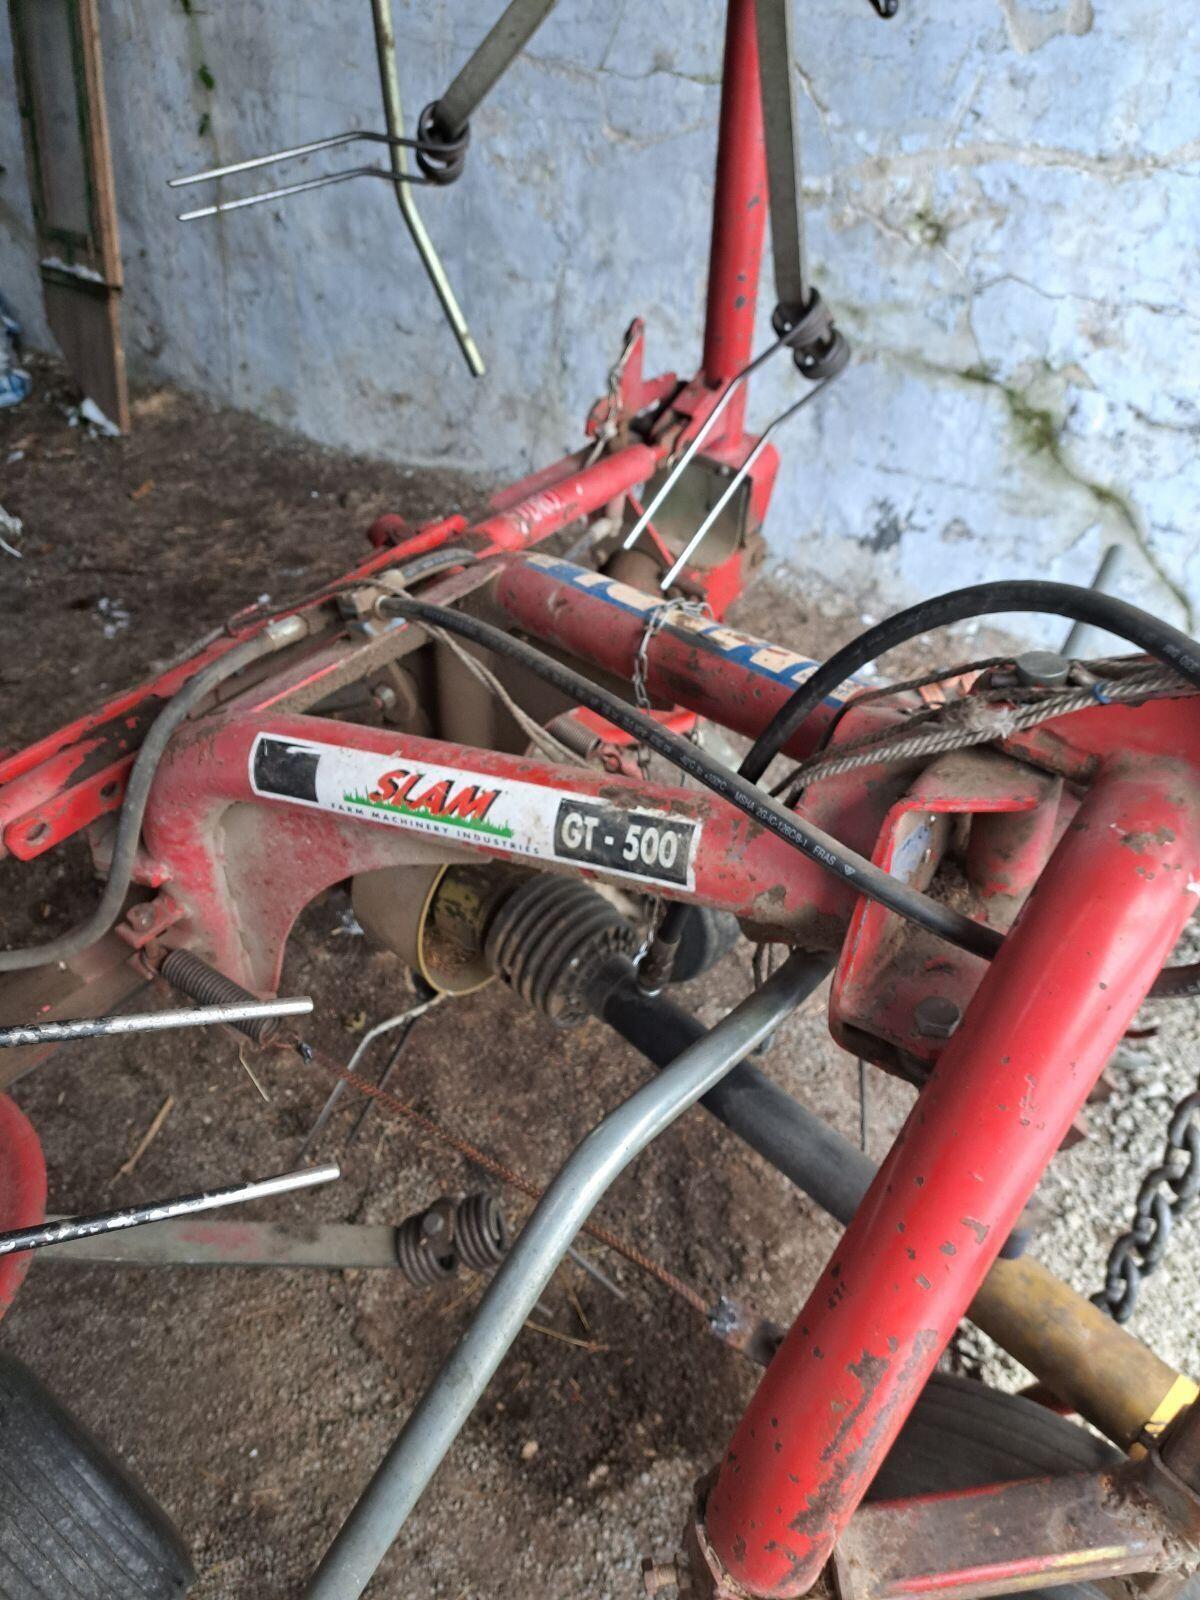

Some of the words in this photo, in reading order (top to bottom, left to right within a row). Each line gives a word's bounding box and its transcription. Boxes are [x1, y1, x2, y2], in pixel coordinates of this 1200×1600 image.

[368, 769, 502, 822] SLAM
[331, 802, 364, 816] FARM
[371, 811, 449, 835] MACHINERY
[456, 830, 540, 855] INDUSTRIES
[561, 811, 600, 851] GT
[622, 824, 678, 869] 500
[734, 791, 756, 811] MSHA
[812, 845, 837, 866] FRAS
